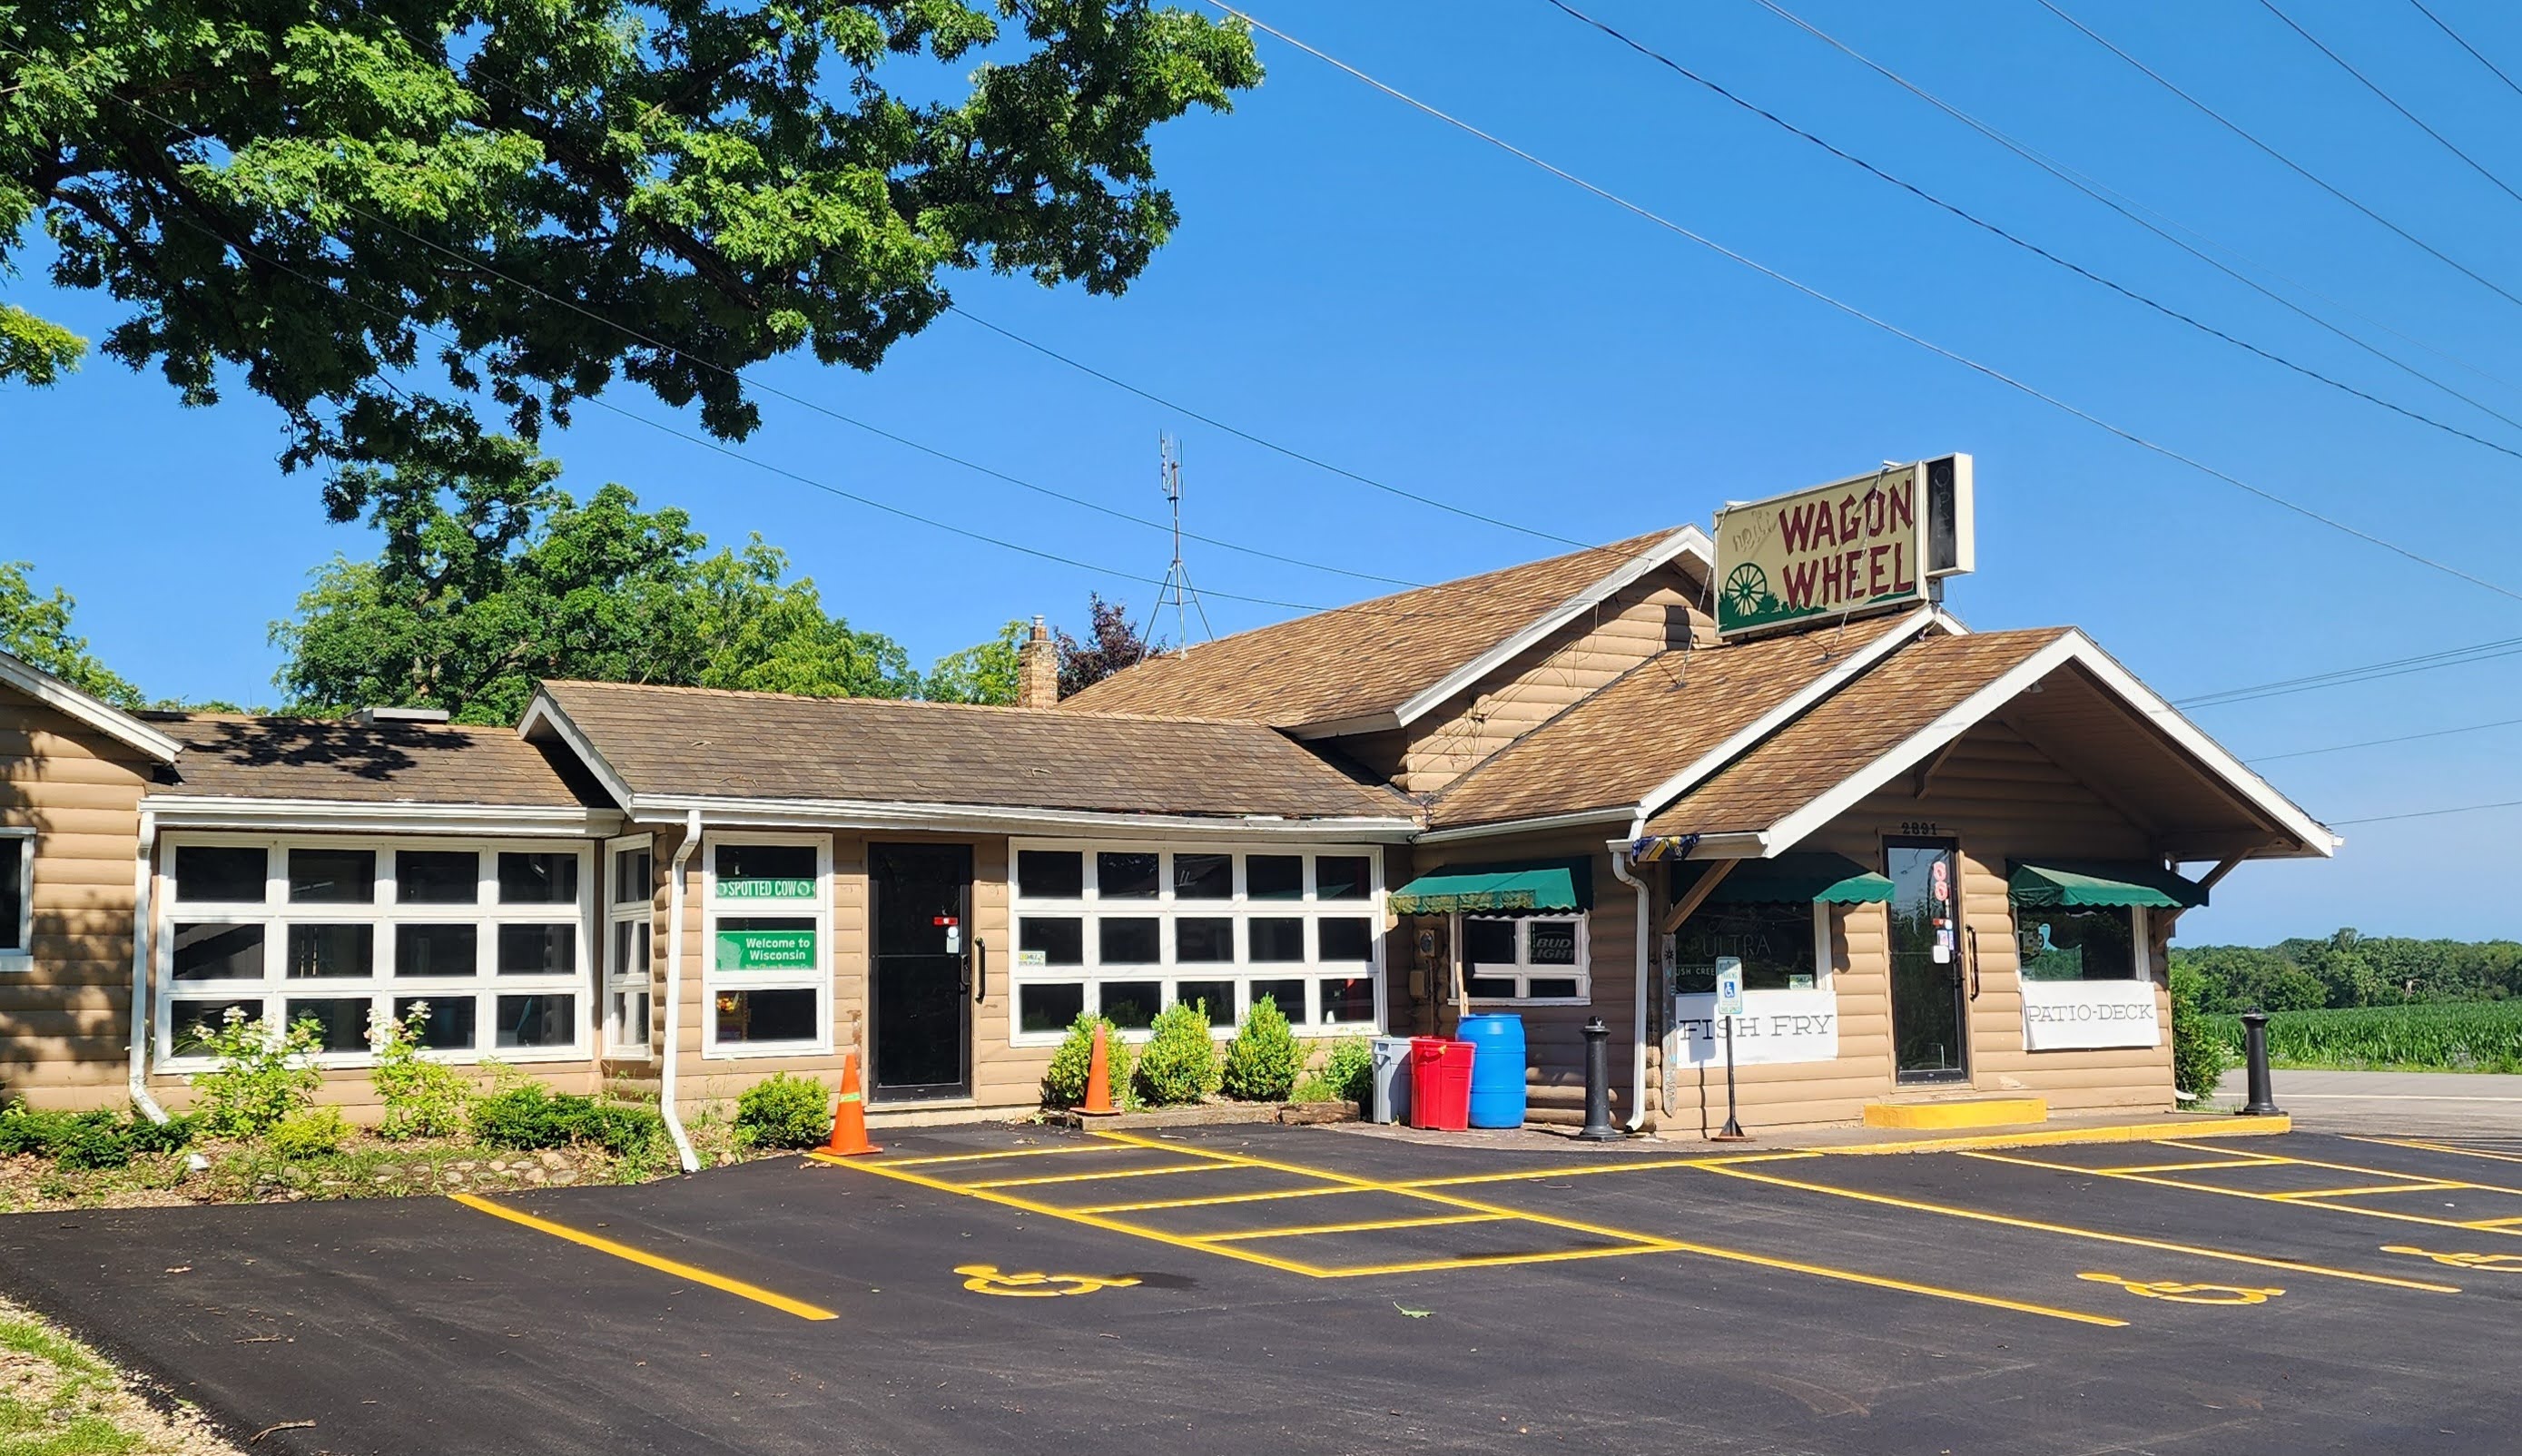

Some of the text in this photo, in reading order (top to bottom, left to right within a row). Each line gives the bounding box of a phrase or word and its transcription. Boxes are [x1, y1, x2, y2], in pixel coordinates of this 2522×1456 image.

[1778, 479, 1914, 556] WAGON
[1782, 542, 1914, 611] WHEEL
[1901, 821, 1937, 835] 2891
[728, 880, 796, 896] SPOTTED COW
[746, 938, 810, 949] Welcome to
[1536, 939, 1571, 948] BUD
[750, 949, 806, 960] Wisconsin
[1696, 965, 1715, 976] CREE
[2025, 1004, 2153, 1022] PATIO-DECK
[1679, 1014, 1834, 1041] FISH FRY
